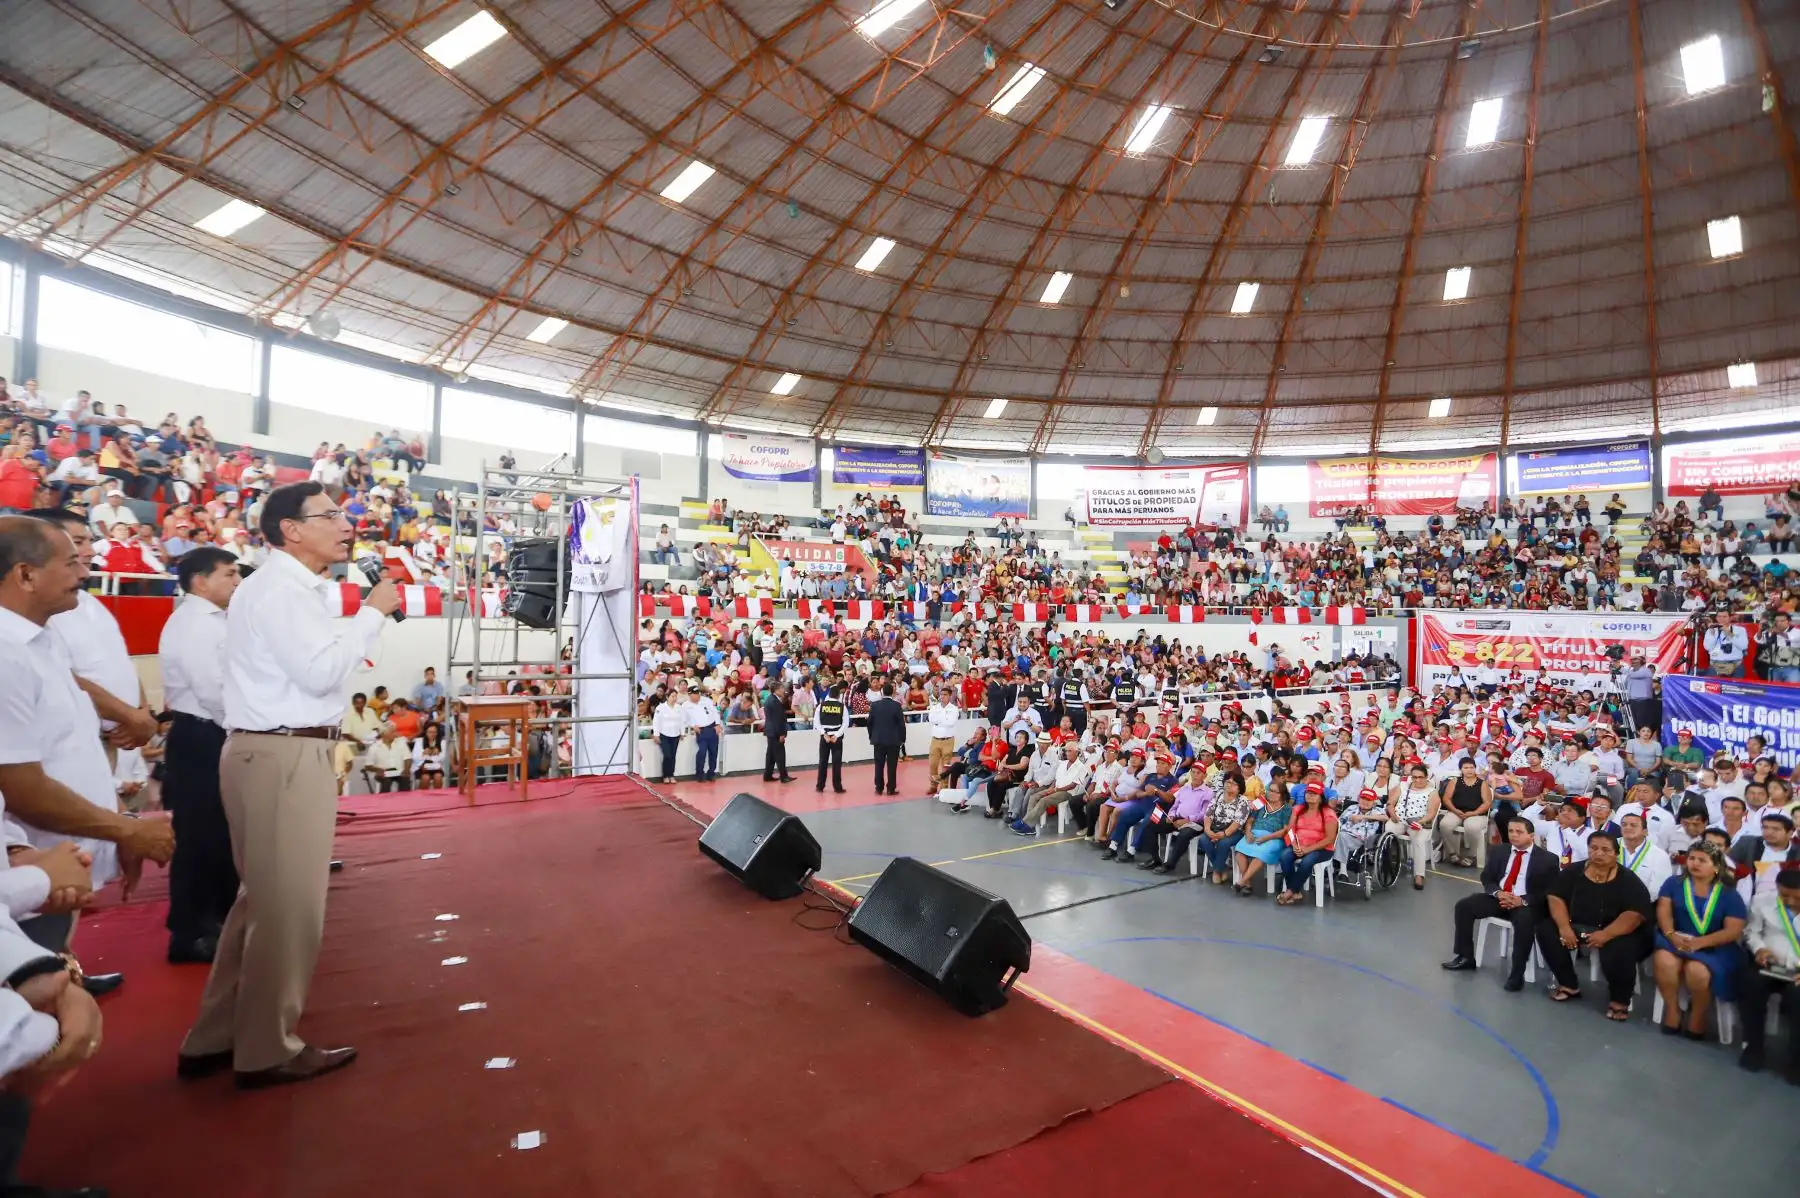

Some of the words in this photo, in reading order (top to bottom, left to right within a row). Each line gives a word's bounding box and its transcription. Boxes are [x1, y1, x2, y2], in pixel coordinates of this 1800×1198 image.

[750, 445, 790, 455] COFOPRI
[1329, 462, 1390, 473] GRACIAS
[1394, 462, 1404, 470] A
[1408, 460, 1472, 470] COFOPRI
[1685, 467, 1708, 477] SIN
[1364, 476, 1381, 485] de
[1384, 475, 1455, 488] propiedad
[1684, 476, 1711, 486] MÁS
[1178, 486, 1196, 494] MÁS
[1371, 490, 1455, 500] FRONTERAS
[1092, 496, 1131, 505] TÍTULOS
[1144, 497, 1196, 505] PROPIEDAD
[1115, 505, 1132, 513] MÁS
[1317, 506, 1336, 516] del
[770, 547, 832, 560] SALIDA
[1602, 623, 1652, 631] COFOPRI
[1630, 646, 1660, 657] DE
[1540, 659, 1610, 671] PROPIE
[821, 705, 841, 714] POLICIA
[1733, 705, 1750, 724] El
